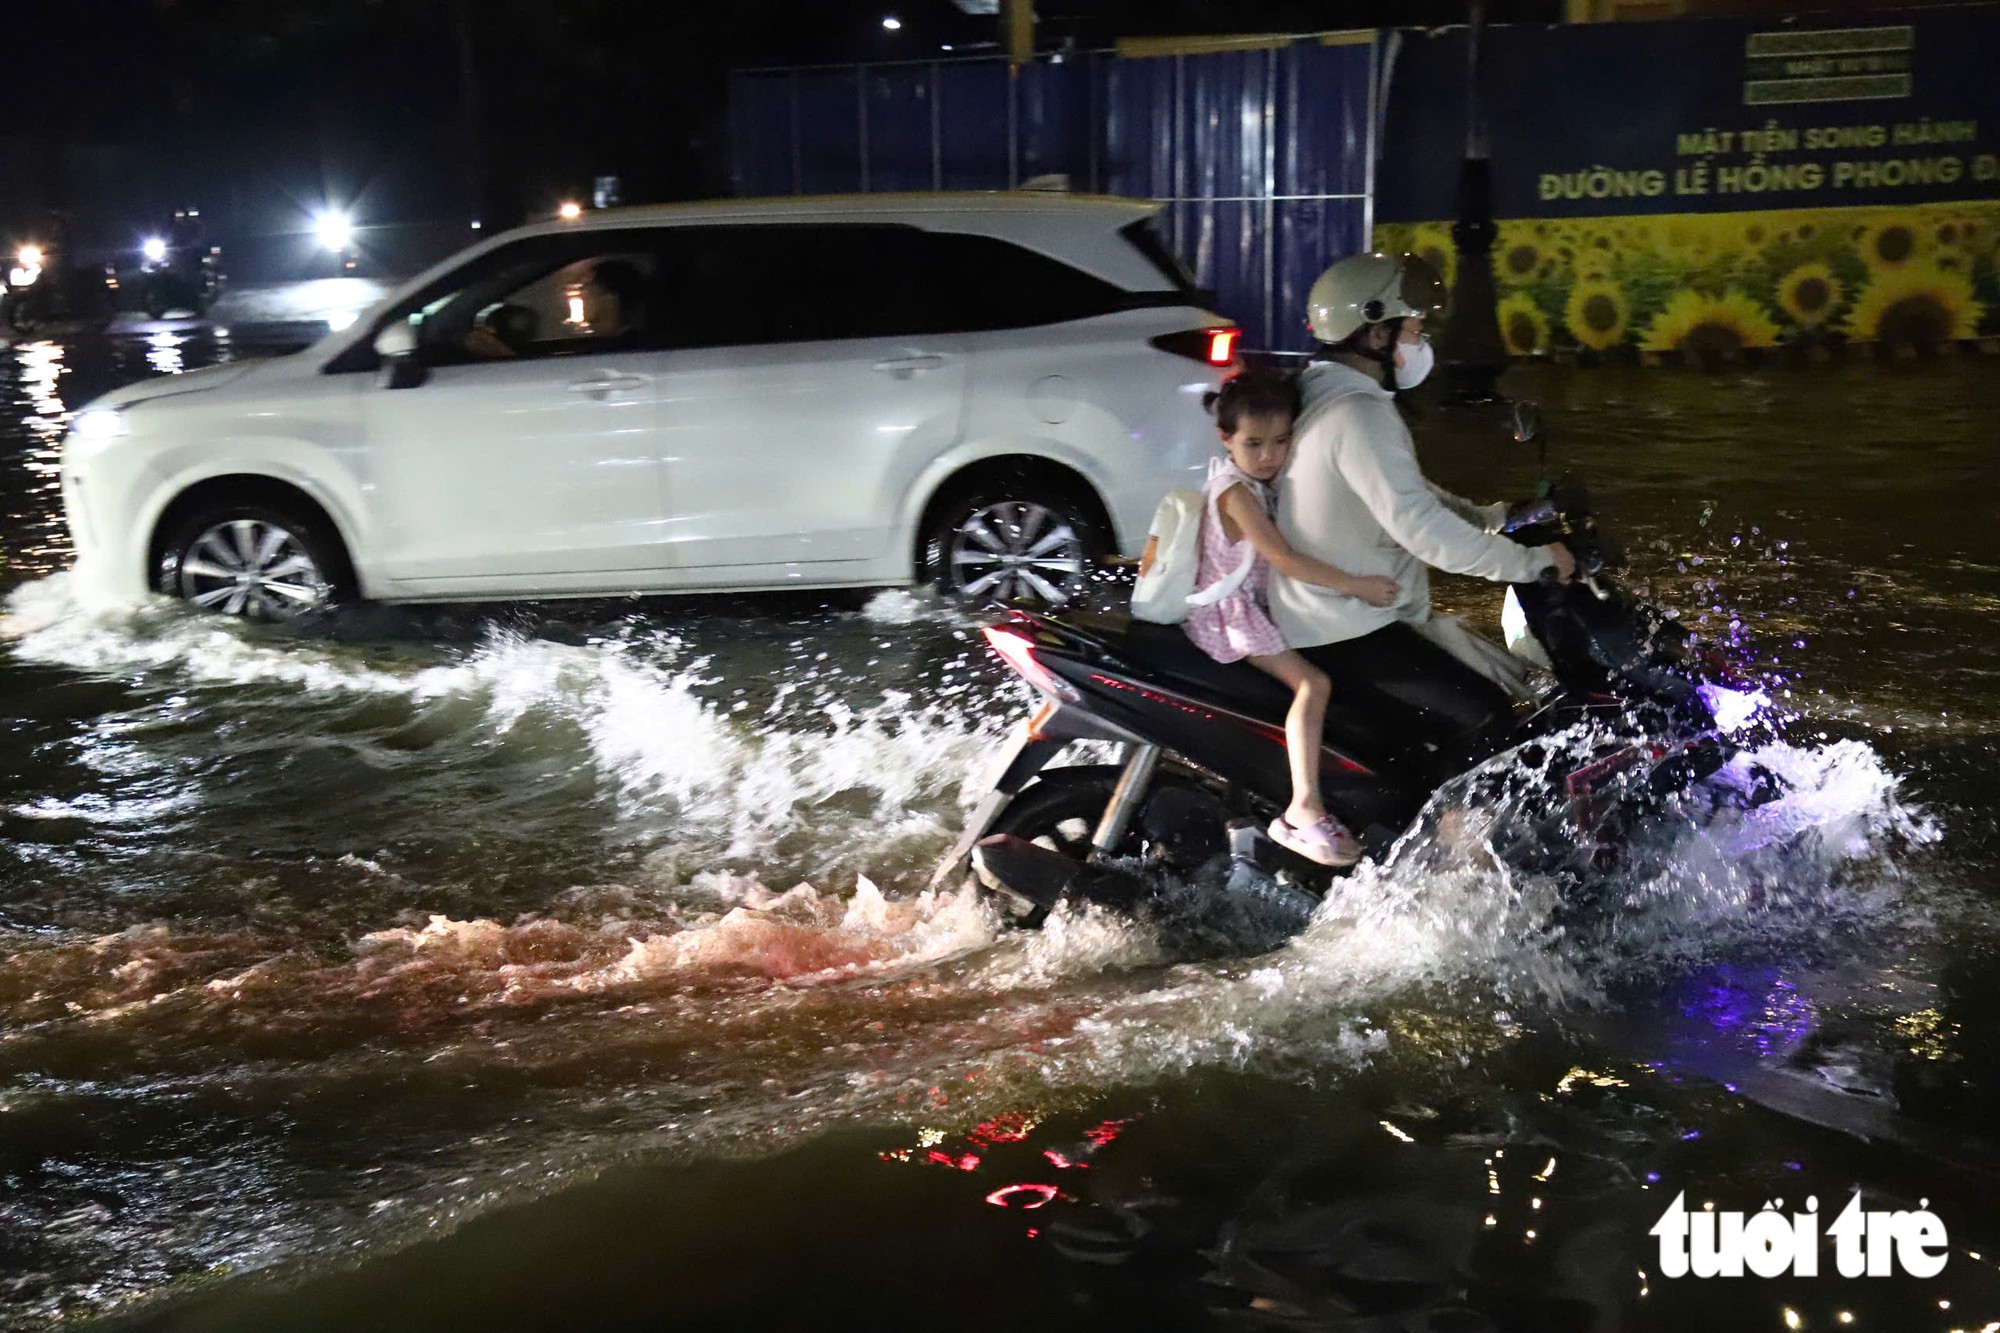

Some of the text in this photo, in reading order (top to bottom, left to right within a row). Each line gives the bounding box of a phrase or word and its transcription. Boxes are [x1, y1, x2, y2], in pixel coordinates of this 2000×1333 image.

[1805, 124, 1888, 151] SONG
[1539, 164, 1666, 200] ĐƯỜNG
[1716, 152, 1825, 193] HỒNG
[1832, 156, 1963, 189] PHONG
